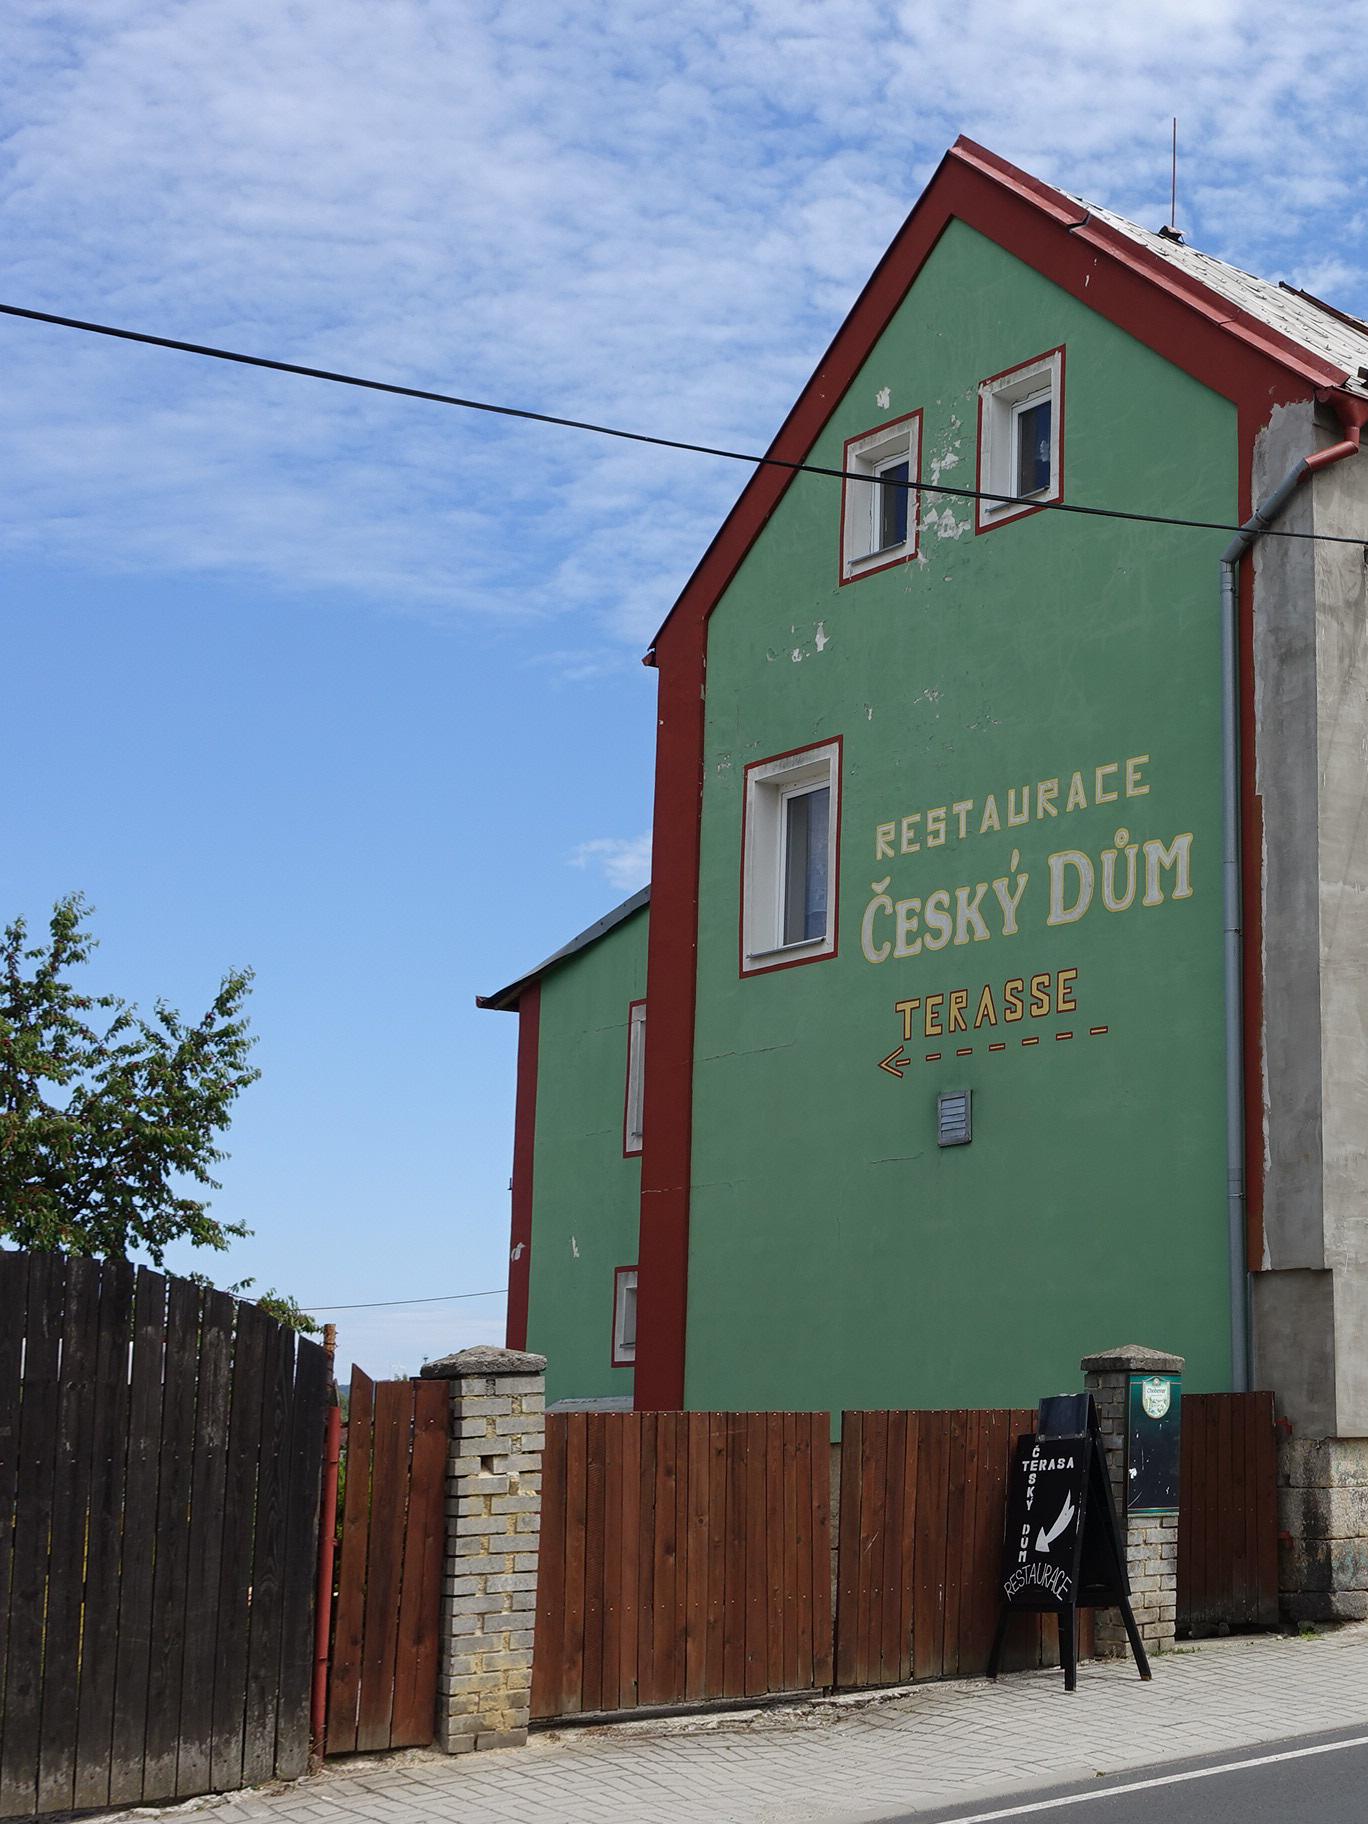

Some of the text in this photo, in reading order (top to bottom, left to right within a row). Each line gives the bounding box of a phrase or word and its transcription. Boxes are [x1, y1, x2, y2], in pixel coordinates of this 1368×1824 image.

[876, 755, 1151, 860] RESTAURACE
[861, 828, 1194, 964] ČESKÝ DŮM
[895, 968, 1078, 1040] TERASSE
[1022, 1457, 1075, 1472] TERASA
[1003, 1562, 1073, 1602] RESTAURACE
